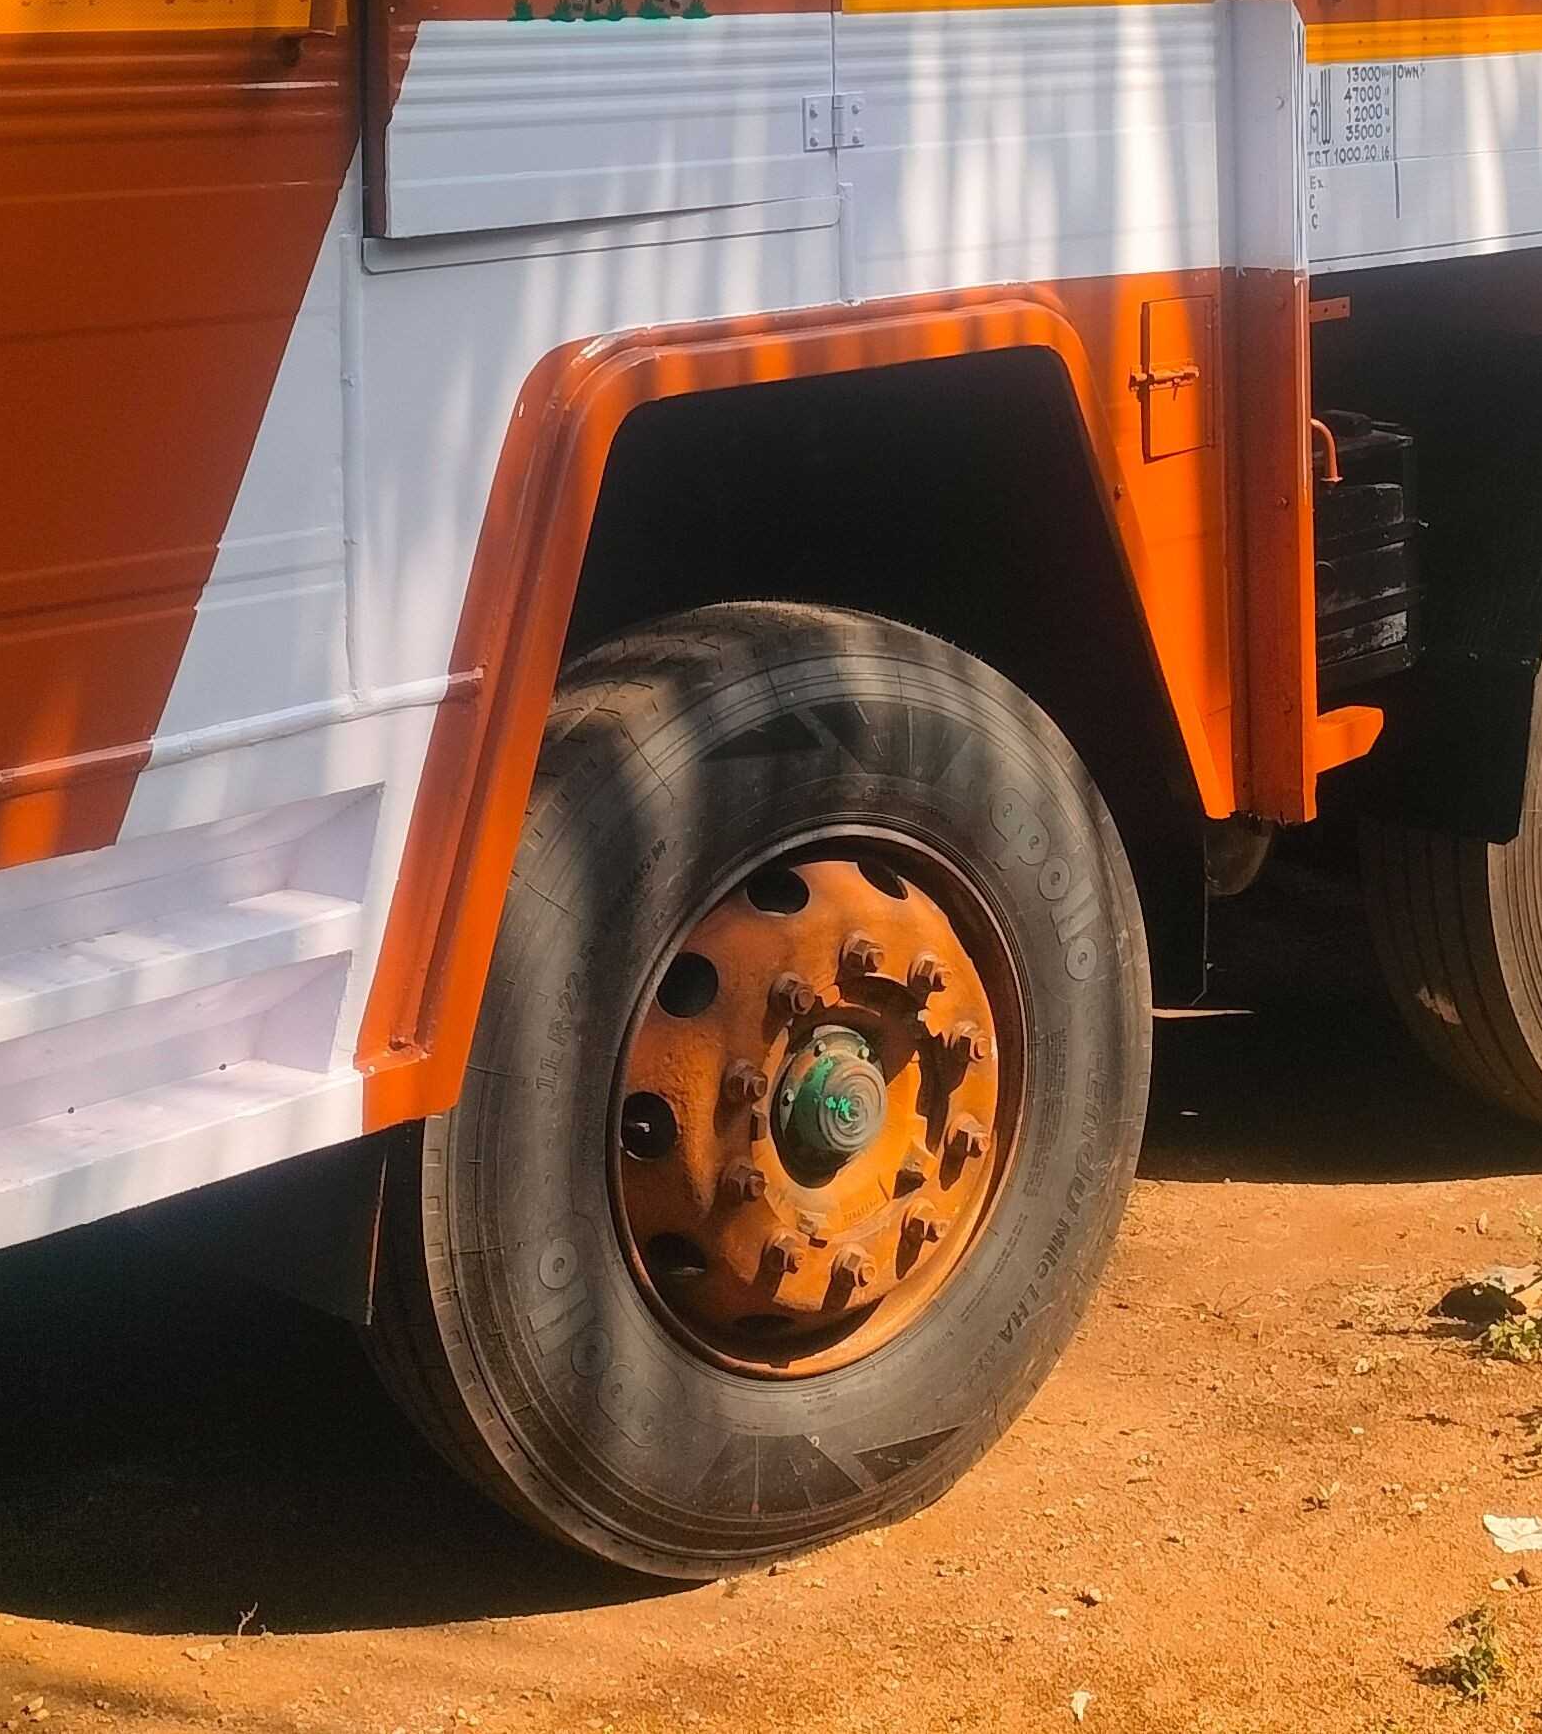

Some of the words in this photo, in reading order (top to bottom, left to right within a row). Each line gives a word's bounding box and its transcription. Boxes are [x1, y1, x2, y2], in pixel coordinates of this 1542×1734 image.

[1346, 66, 1381, 83] 13000
[1343, 85, 1381, 104] 47000
[1346, 103, 1383, 123] 12000
[1345, 123, 1383, 142] 35000
[989, 786, 1101, 983] apollo
[526, 1237, 674, 1449] apollo
